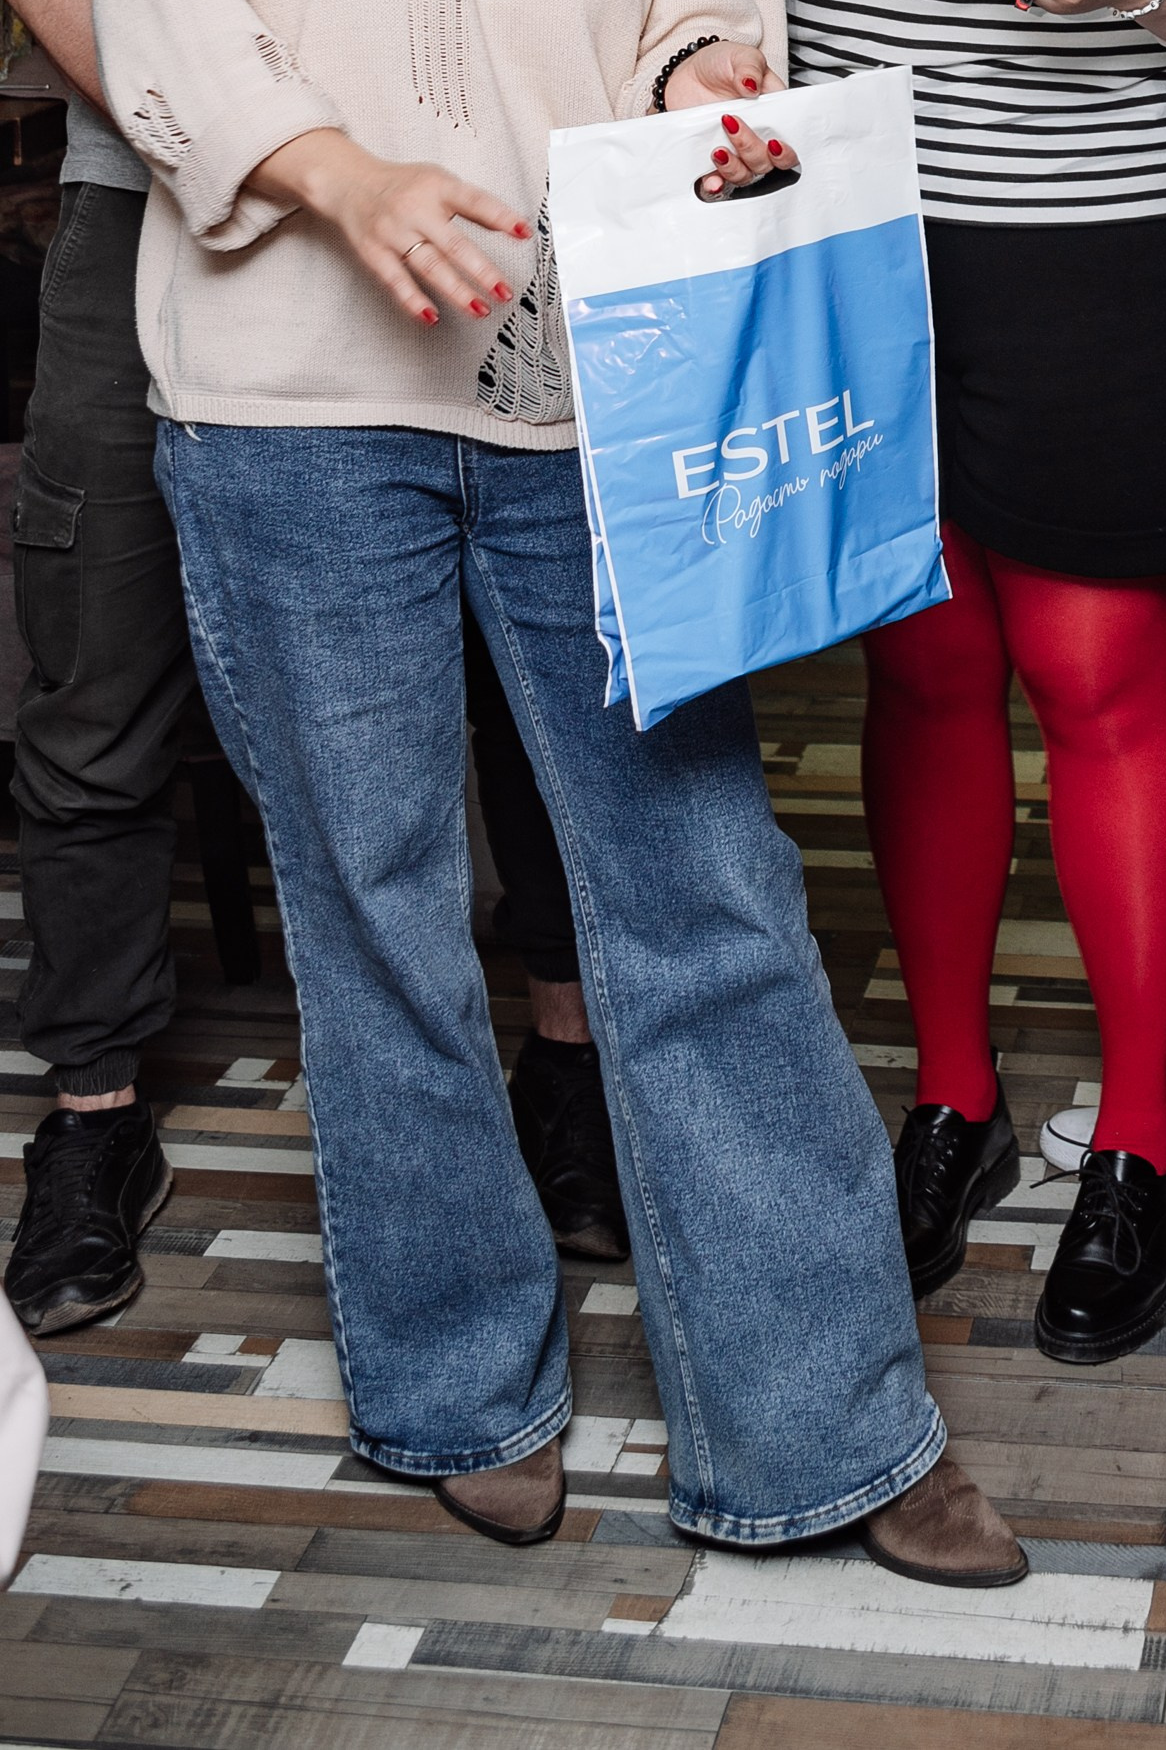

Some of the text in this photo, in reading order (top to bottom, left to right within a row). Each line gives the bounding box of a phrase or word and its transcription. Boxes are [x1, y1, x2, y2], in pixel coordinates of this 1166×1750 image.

[672, 389, 875, 499] ESTEL
[702, 432, 884, 544] Радость подари
